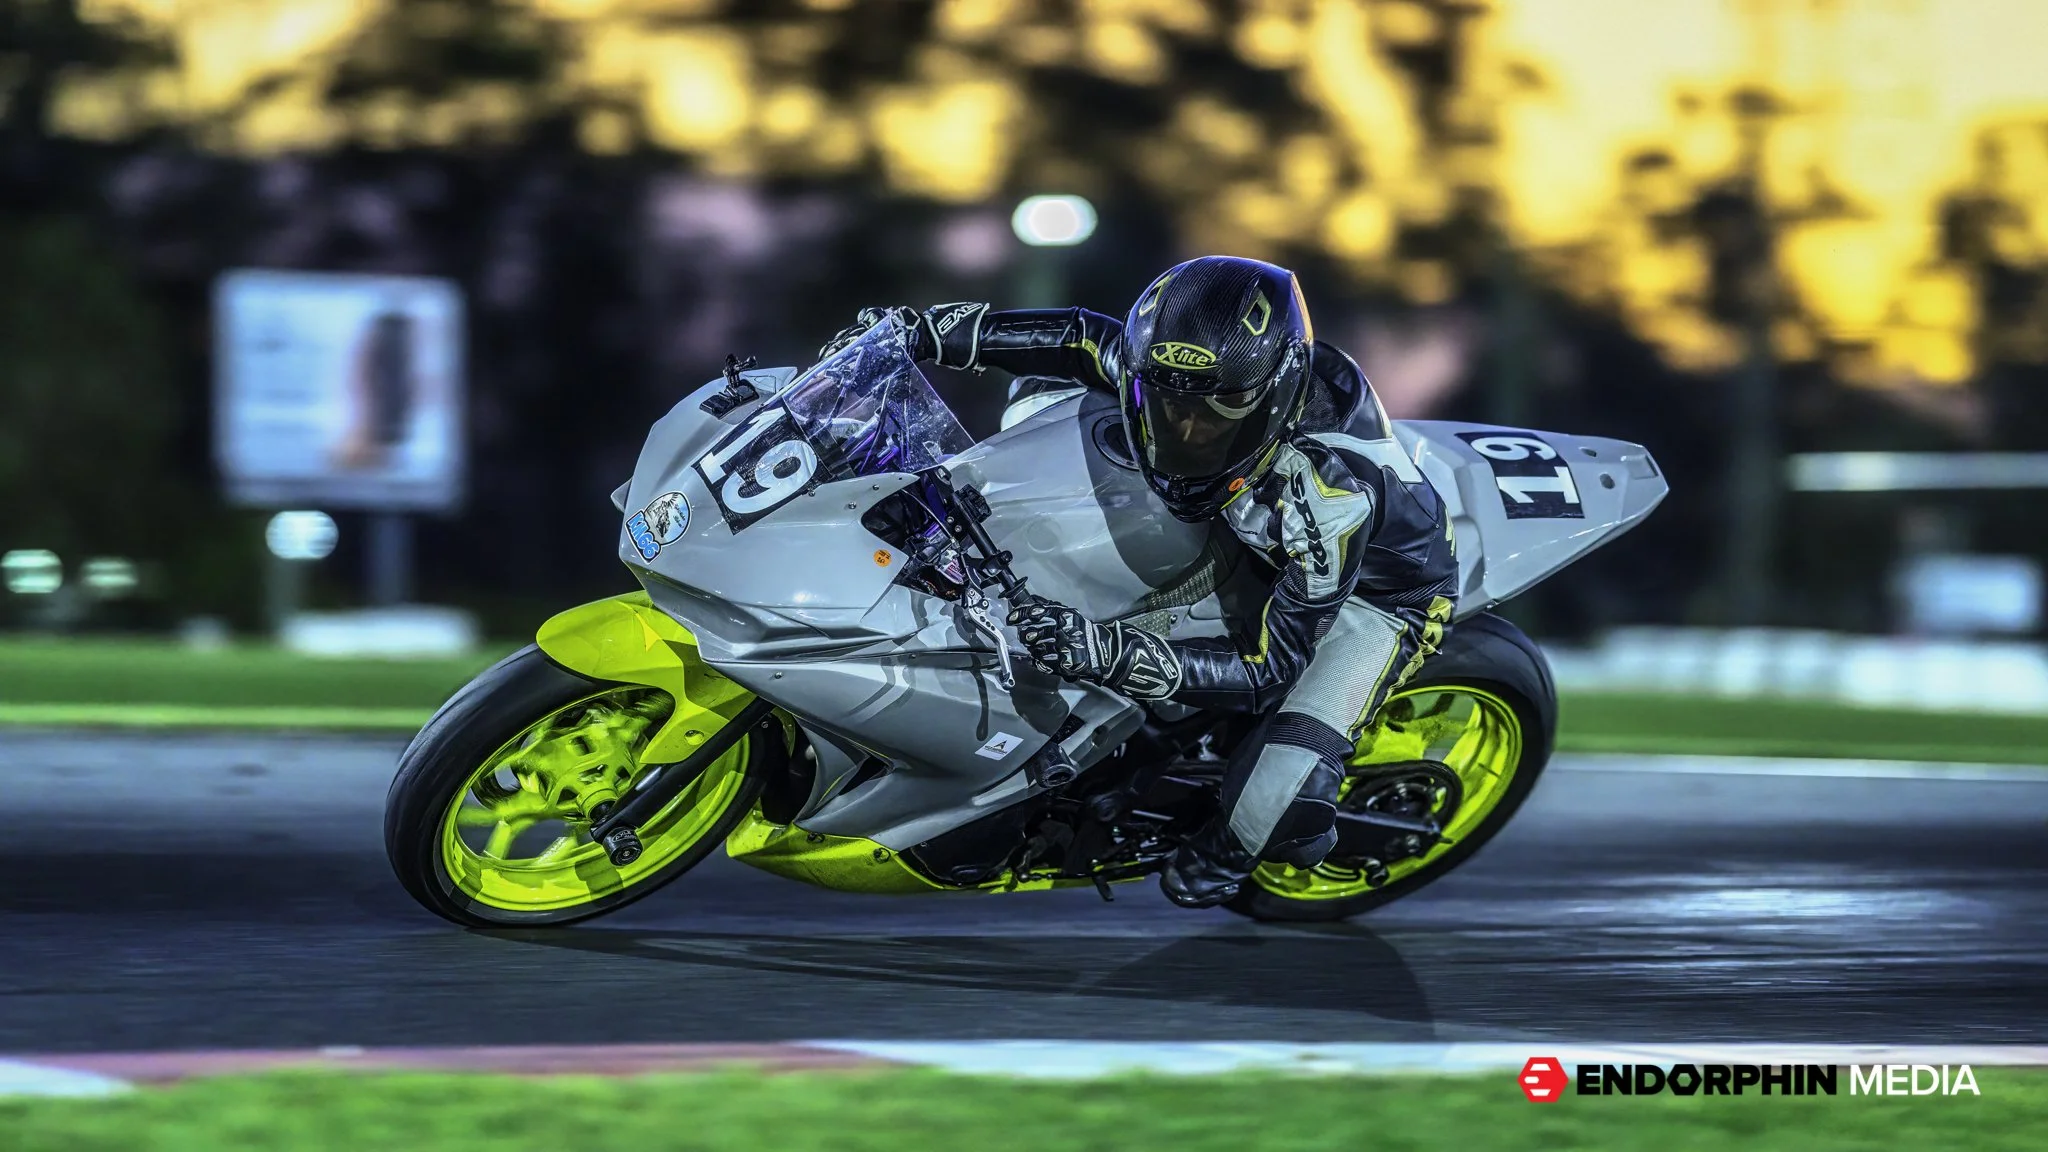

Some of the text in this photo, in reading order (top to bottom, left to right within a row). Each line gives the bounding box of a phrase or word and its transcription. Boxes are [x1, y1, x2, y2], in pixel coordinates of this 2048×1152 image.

[1157, 342, 1209, 366] X-lite
[699, 407, 818, 514] 19
[1470, 436, 1580, 504] 19
[627, 511, 660, 559] KM66
[1290, 471, 1329, 577] SPIDI
